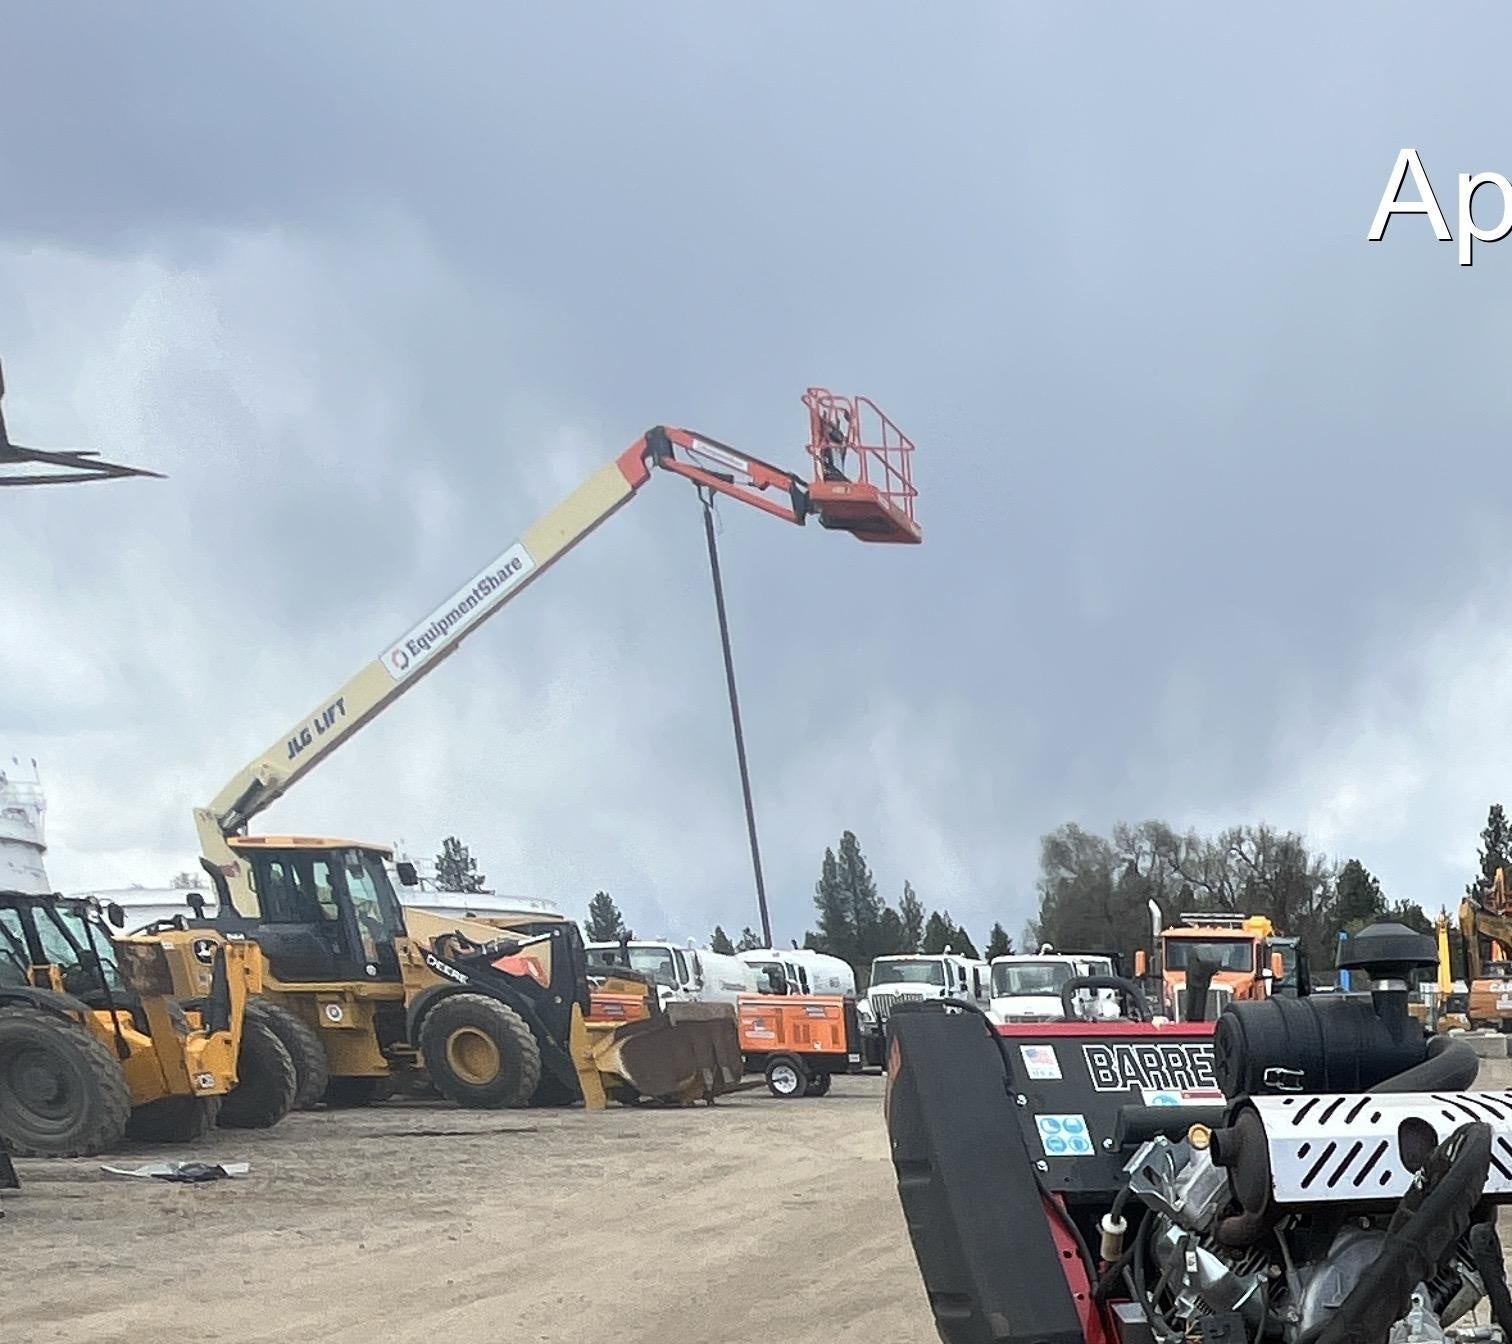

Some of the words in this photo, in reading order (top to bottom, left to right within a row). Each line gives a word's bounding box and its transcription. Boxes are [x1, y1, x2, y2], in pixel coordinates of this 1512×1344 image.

[404, 557, 523, 657] EquipmentShare
[287, 727, 313, 760] JLG
[314, 696, 346, 735] LIFT
[427, 954, 469, 984] DEERE
[1082, 1043, 1218, 1092] BARRE
